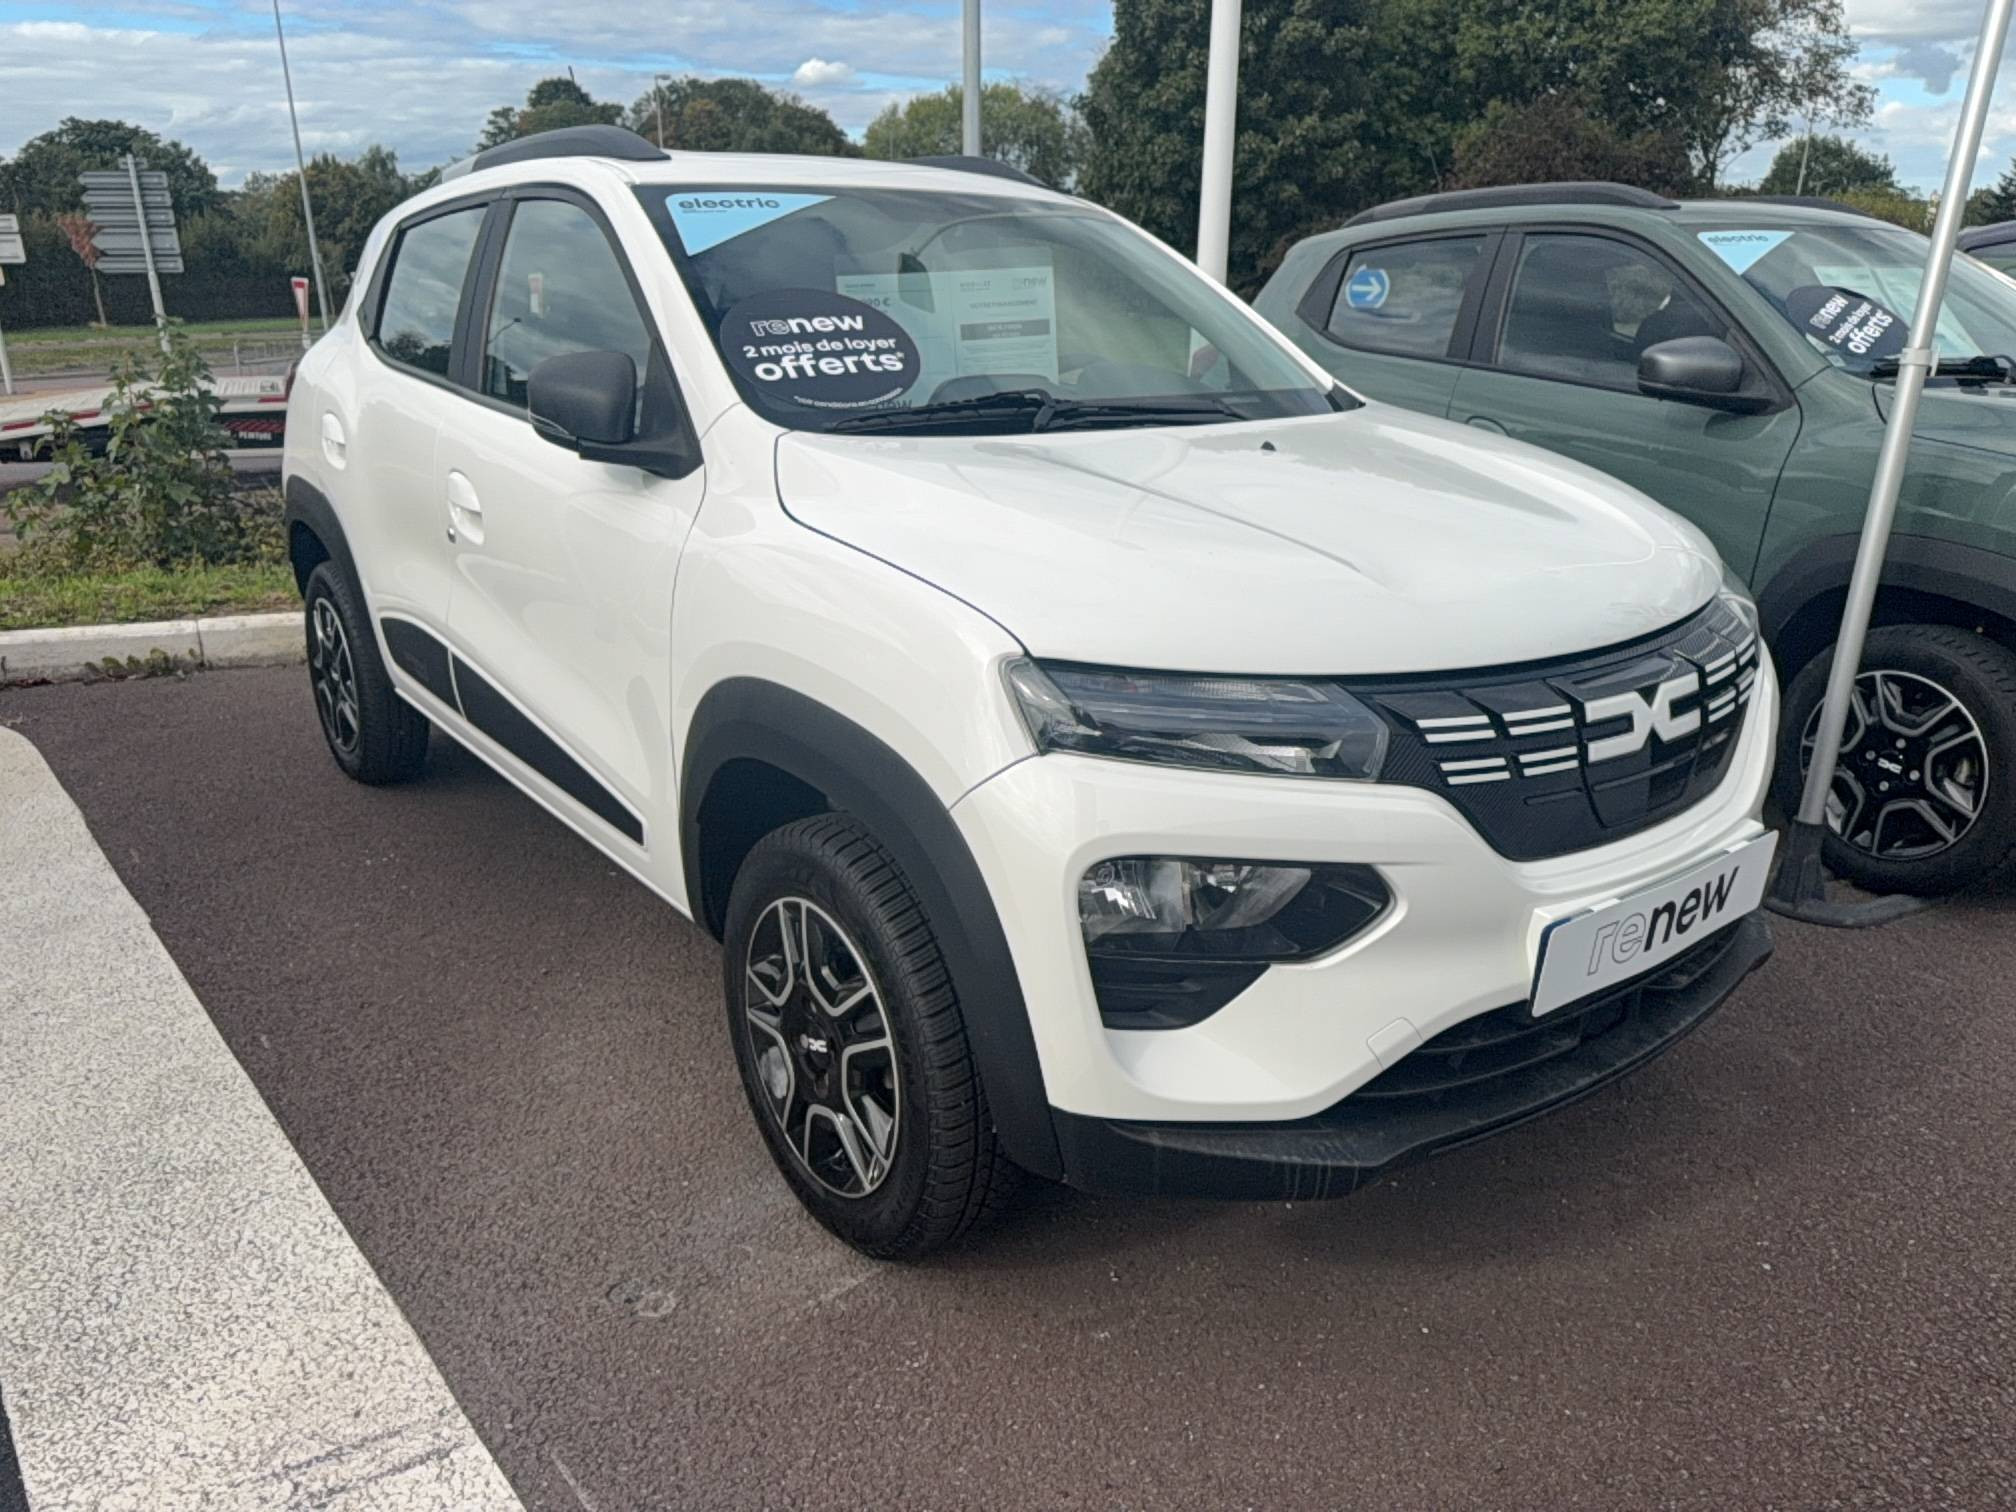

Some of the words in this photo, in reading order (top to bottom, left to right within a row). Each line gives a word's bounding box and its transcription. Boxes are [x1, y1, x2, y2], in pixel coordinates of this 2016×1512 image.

[679, 198, 780, 209] electric
[1809, 294, 1848, 329] renew
[750, 315, 863, 336] renew
[743, 345, 759, 358] 2
[760, 341, 814, 356] mois
[816, 339, 844, 351] de
[845, 337, 896, 352] loyer
[1829, 335, 1841, 345] 2
[1587, 866, 1739, 976] renew
